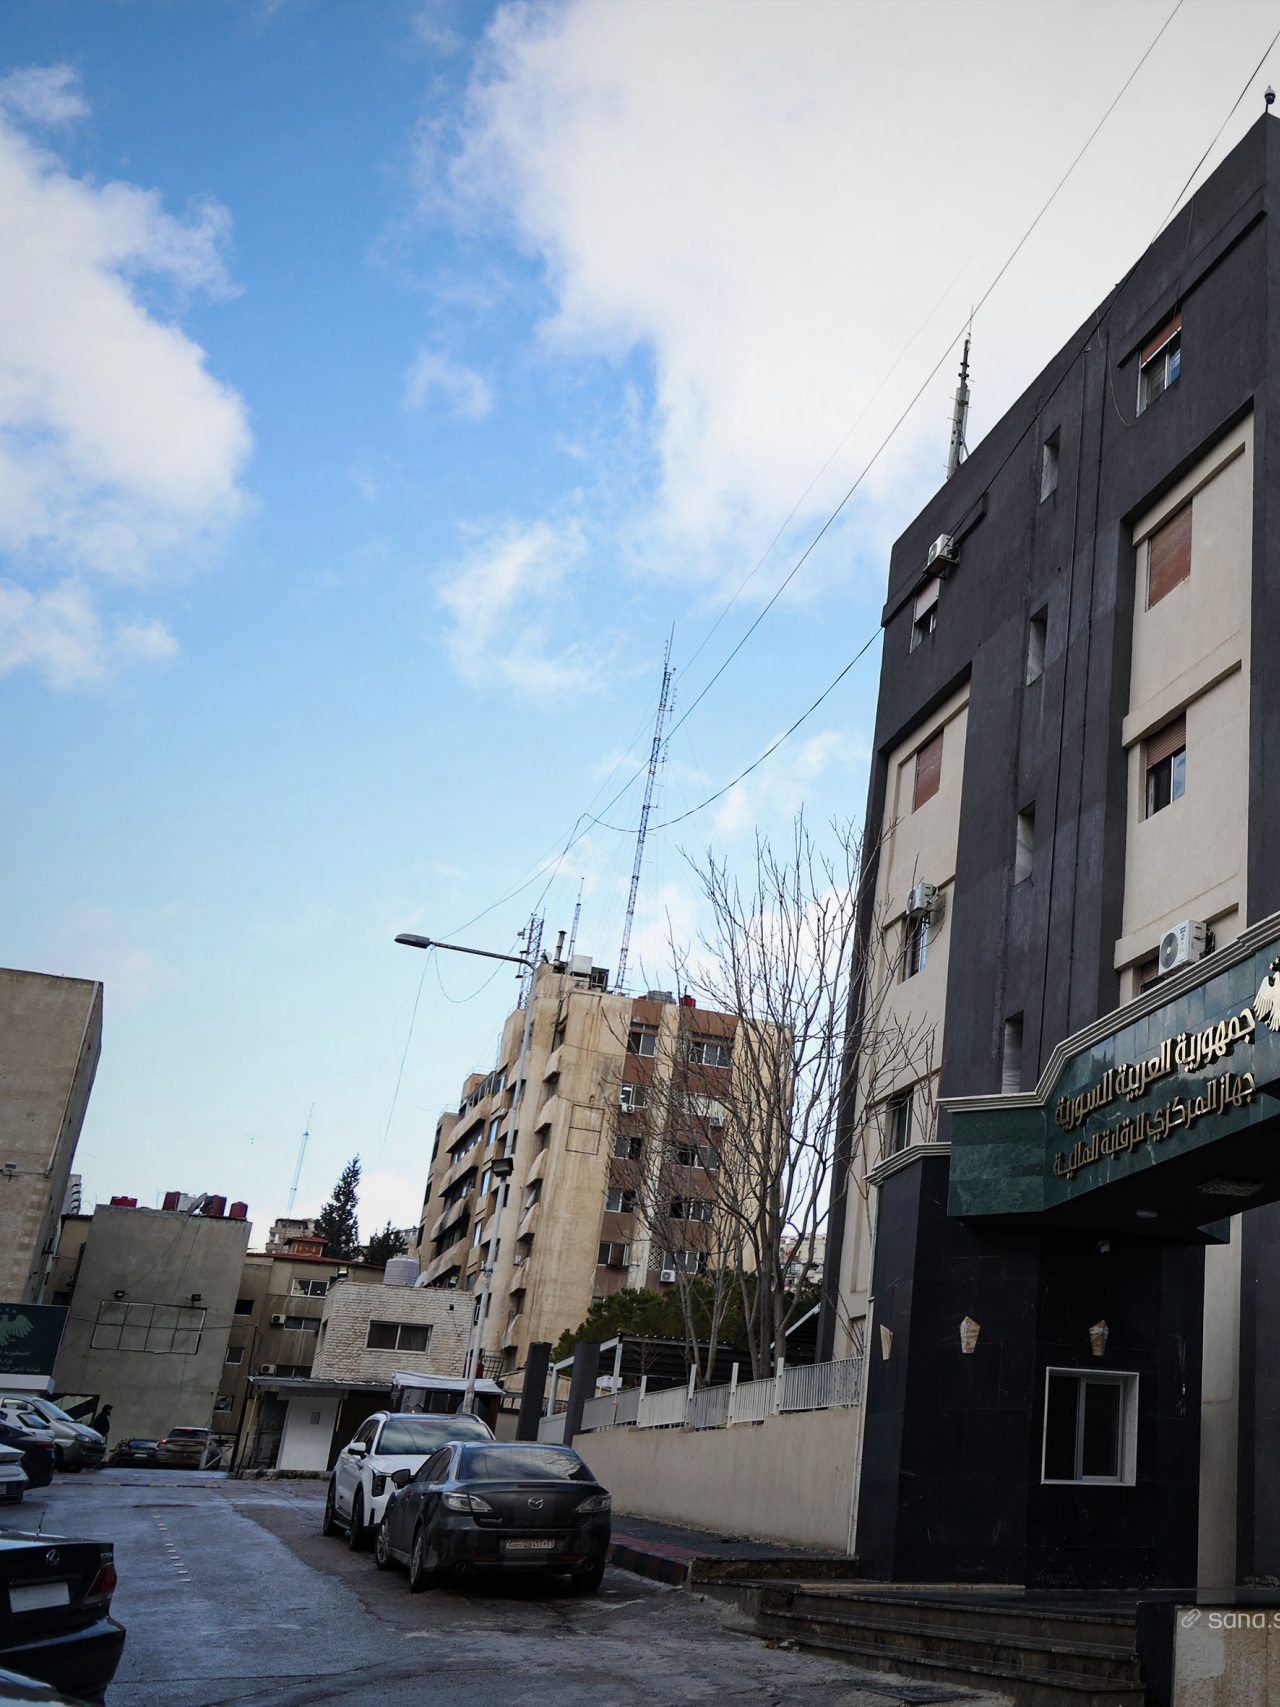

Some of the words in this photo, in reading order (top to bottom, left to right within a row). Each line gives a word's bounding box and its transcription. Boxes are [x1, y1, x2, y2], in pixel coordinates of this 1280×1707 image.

[1056, 1067, 1114, 1131] السورية
[1115, 1038, 1172, 1102] العربية
[1100, 1112, 1146, 1160] للرقابة
[1146, 1078, 1217, 1142] المركزي
[1054, 1132, 1101, 1179] المالية
